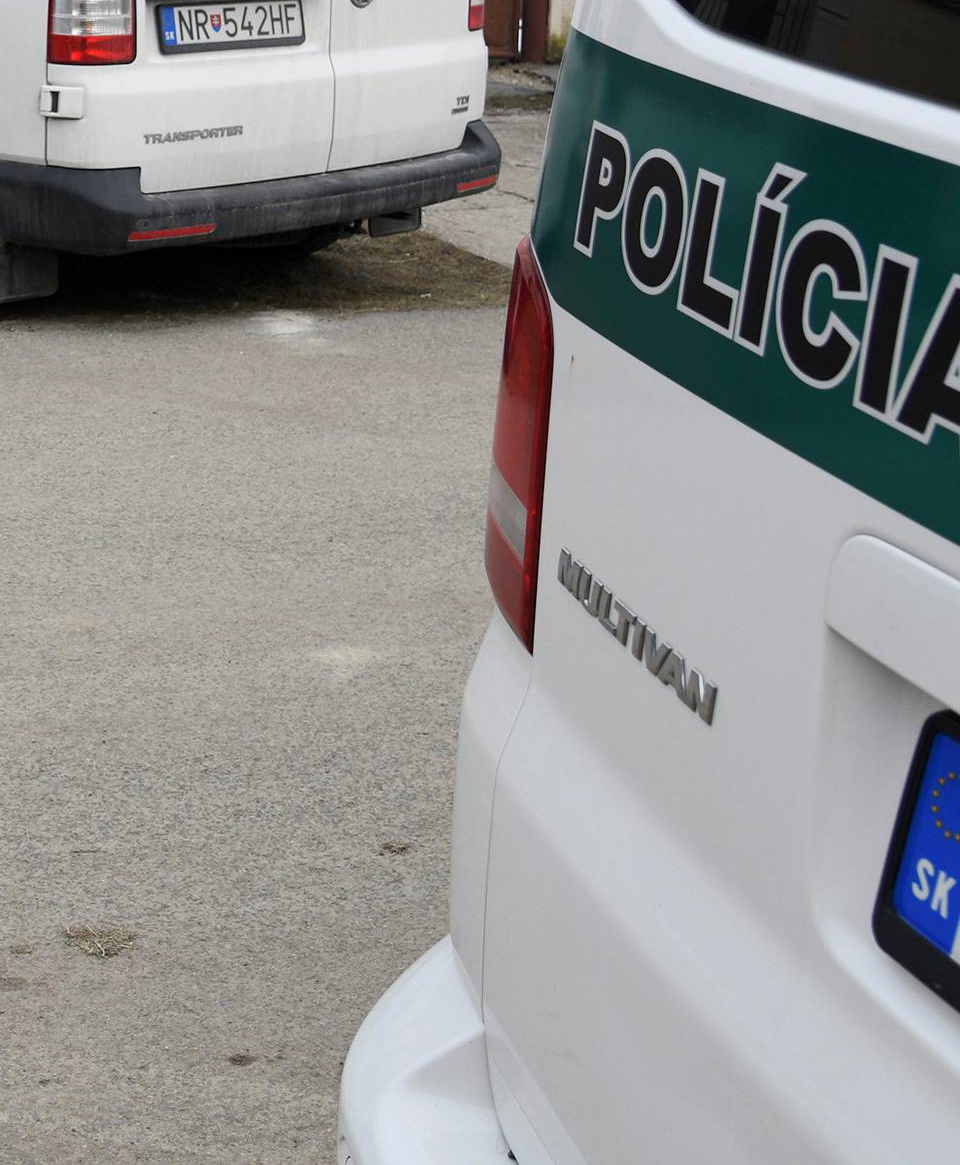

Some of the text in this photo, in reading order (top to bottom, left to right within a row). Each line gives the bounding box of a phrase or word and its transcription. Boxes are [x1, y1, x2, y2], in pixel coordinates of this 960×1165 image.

[164, 31, 176, 41] SK
[177, 3, 297, 41] NR 542HF
[143, 125, 244, 145] TRANSPORTER
[557, 546, 718, 727] MULTIVAN
[911, 857, 957, 920] SK
